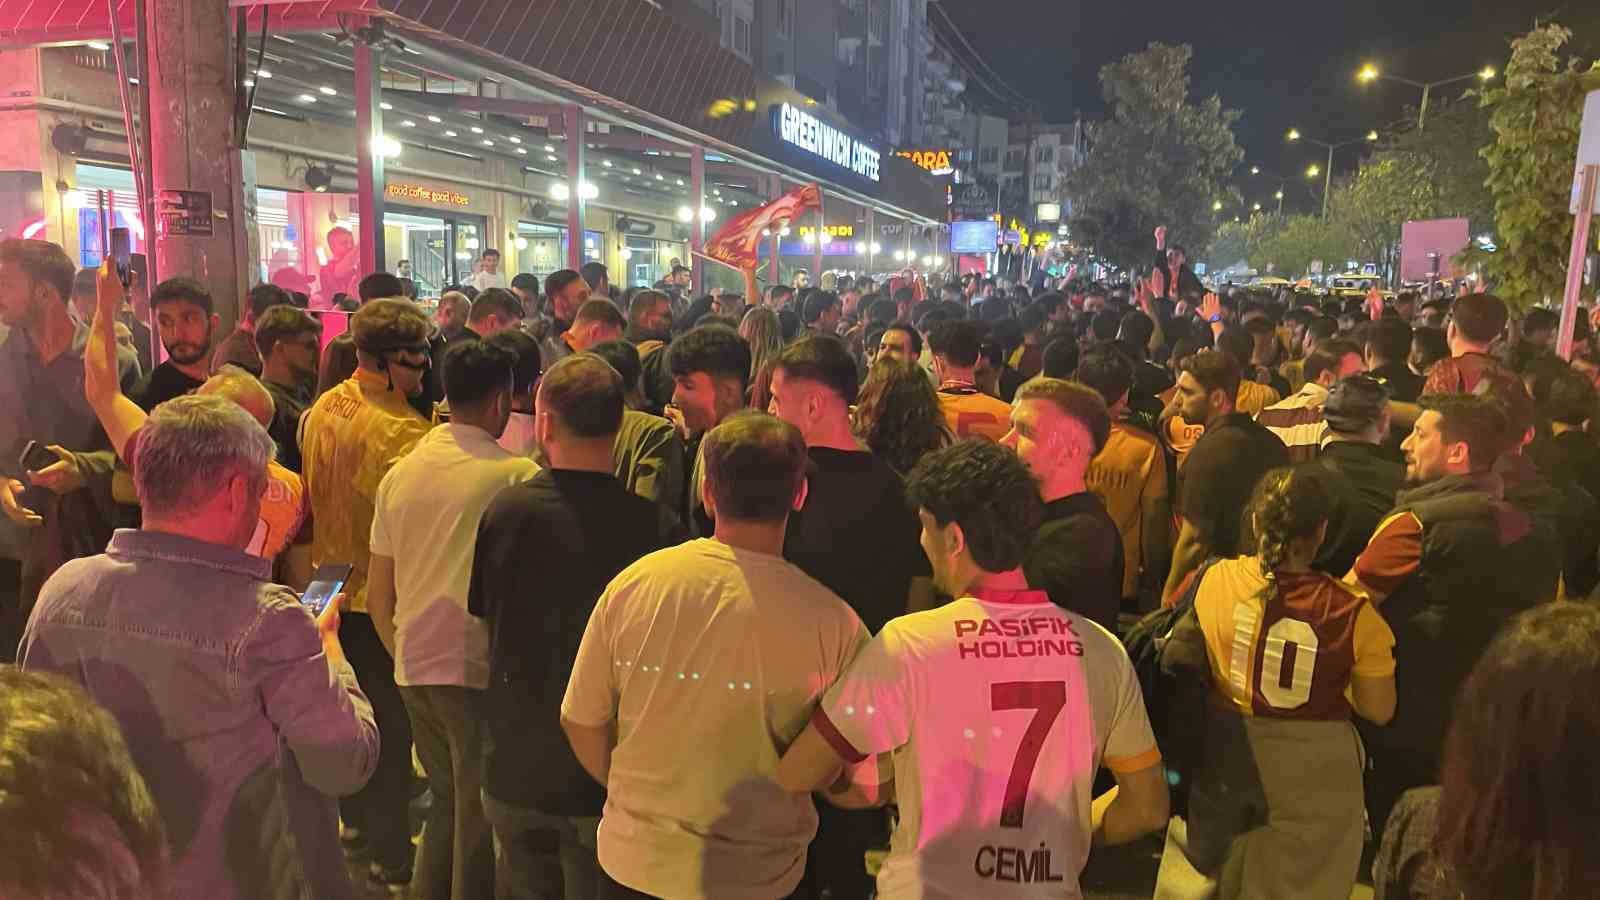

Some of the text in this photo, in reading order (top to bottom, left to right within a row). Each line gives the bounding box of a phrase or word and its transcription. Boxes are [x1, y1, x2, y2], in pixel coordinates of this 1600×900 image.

[781, 102, 880, 182] GREENWICH COFFEE
[896, 151, 950, 171] ARA
[386, 184, 469, 205] good coffee good vibes
[991, 681, 1066, 828] 7
[974, 841, 1063, 883] CEMİL
